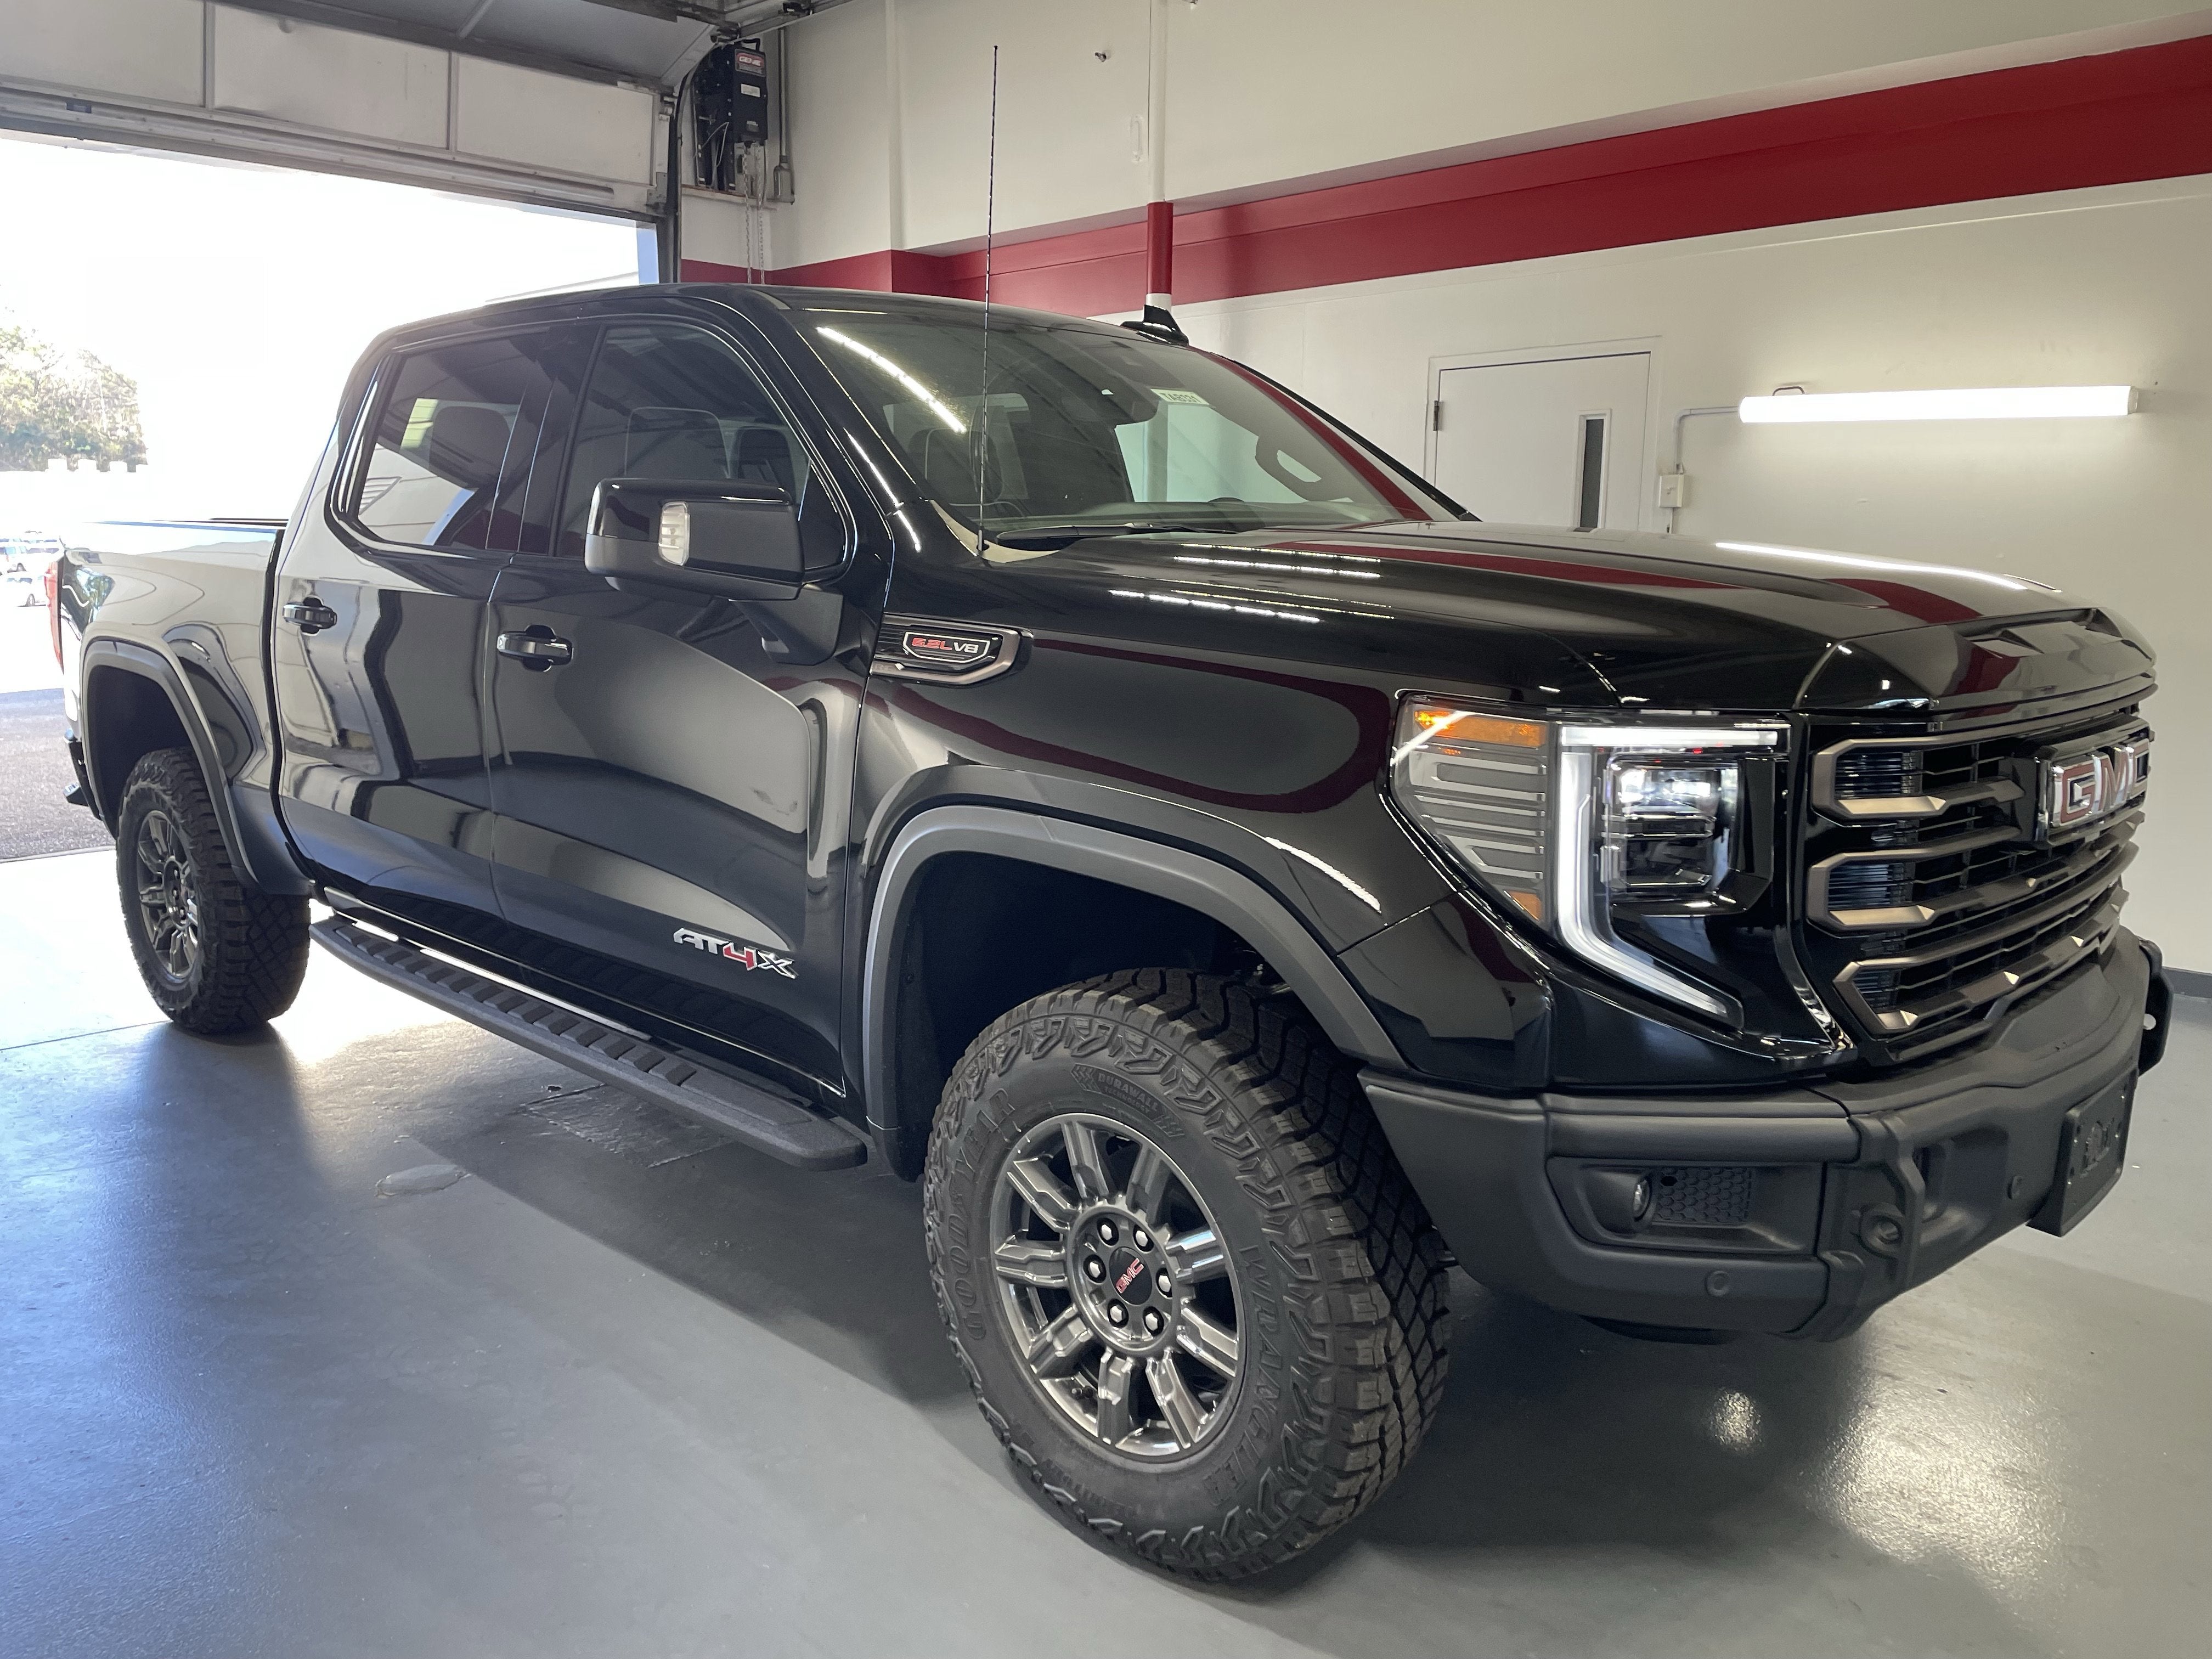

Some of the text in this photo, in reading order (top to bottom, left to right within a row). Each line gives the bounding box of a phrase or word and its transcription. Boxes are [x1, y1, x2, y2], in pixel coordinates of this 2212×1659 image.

[2052, 738, 2150, 827] GMC
[673, 928, 796, 979] AT4X
[1098, 1073, 1158, 1111] DURAWALL
[1104, 1086, 1150, 1114] TECHNOLOGY
[949, 1087, 1016, 1340] GOODYEAR
[1115, 1257, 1144, 1294] GMC
[1204, 1244, 1282, 1506] WRANGLER
